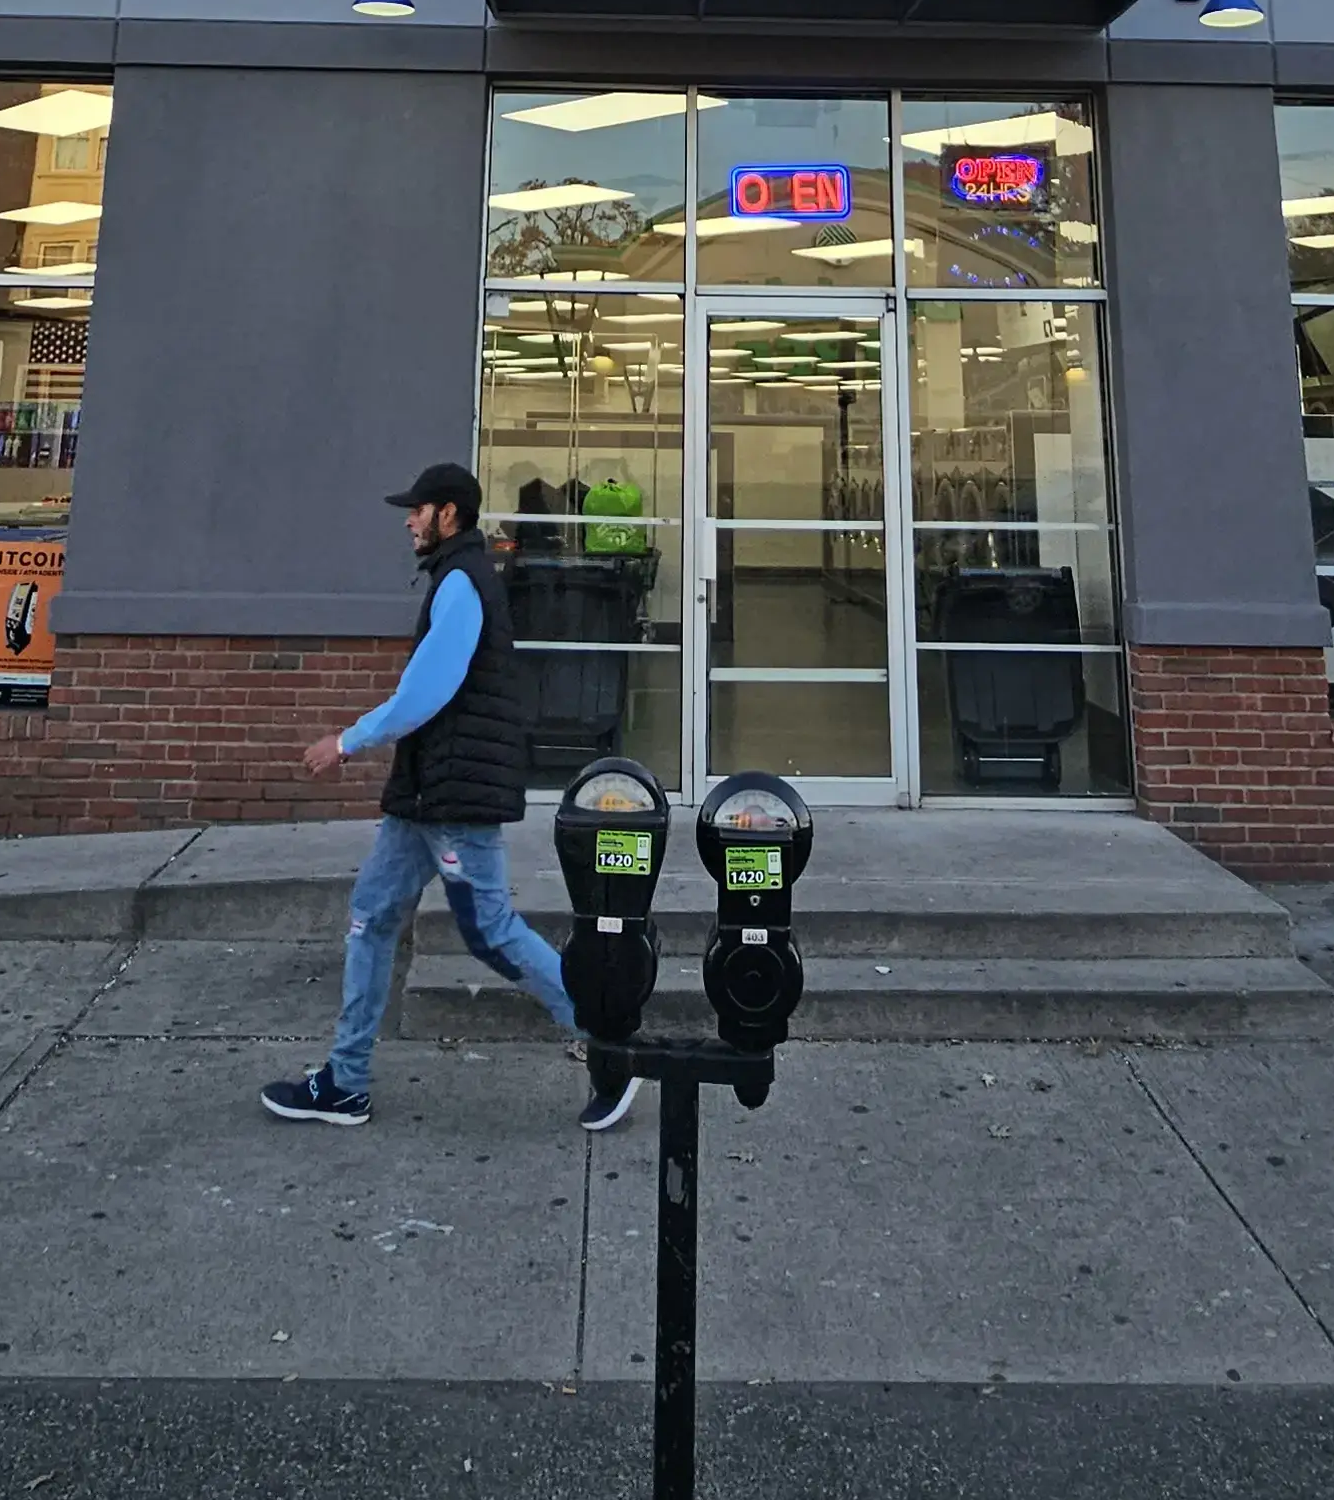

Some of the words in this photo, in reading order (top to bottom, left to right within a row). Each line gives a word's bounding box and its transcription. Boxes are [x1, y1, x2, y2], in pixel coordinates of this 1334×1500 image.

[956, 157, 1038, 183] OPEN
[737, 172, 844, 213] OEN
[599, 853, 632, 867] 1420
[731, 871, 764, 884] 1420
